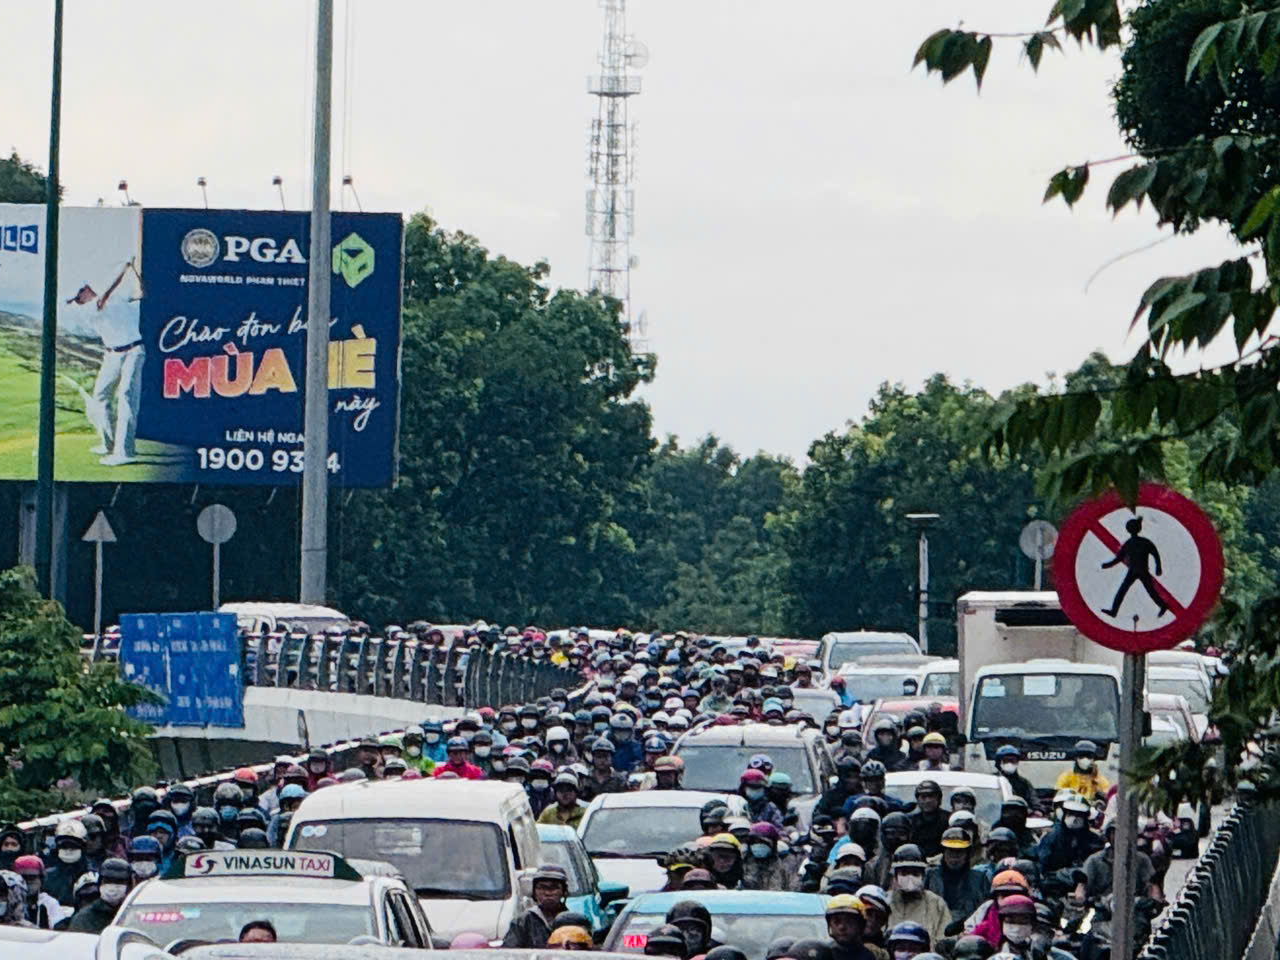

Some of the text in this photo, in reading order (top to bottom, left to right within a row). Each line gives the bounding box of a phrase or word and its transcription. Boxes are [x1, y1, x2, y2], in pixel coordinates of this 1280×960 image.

[223, 235, 307, 264] PGA
[163, 341, 298, 399] MÙA
[334, 395, 381, 432] này
[225, 429, 304, 445] LIÊN HỆ NGA
[196, 447, 342, 474] 1900 934
[1026, 751, 1067, 760] ISUZU
[223, 856, 331, 872] VINASUN TAXI
